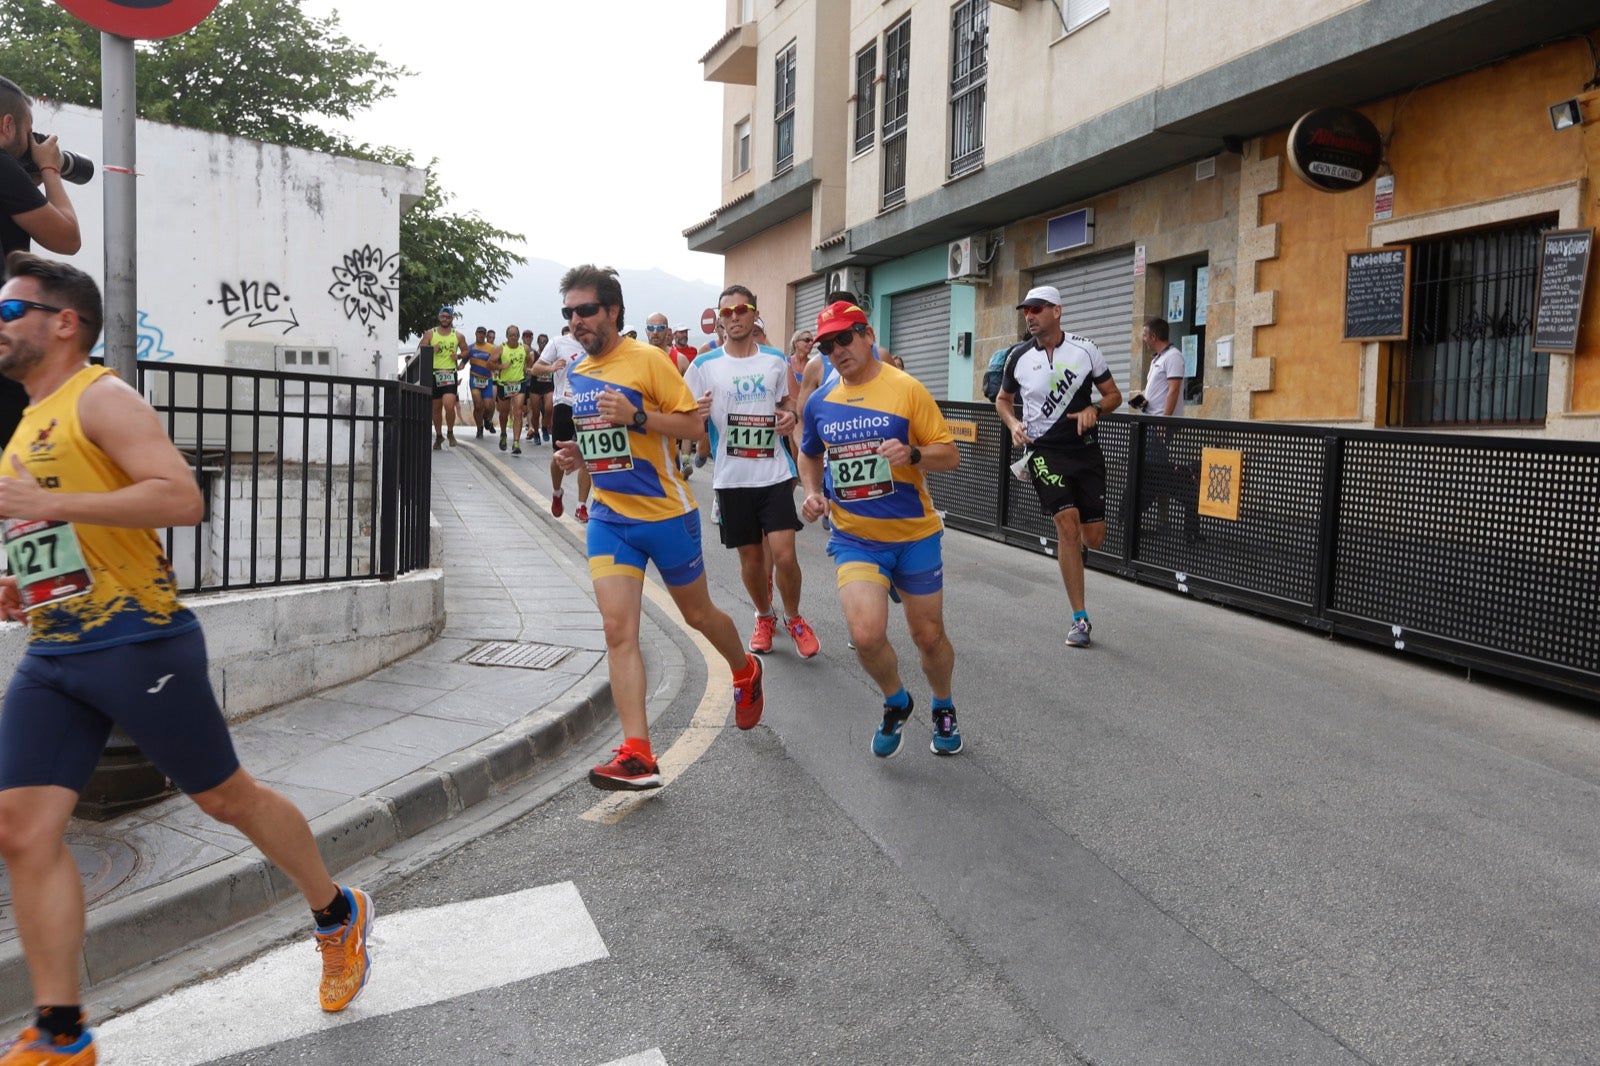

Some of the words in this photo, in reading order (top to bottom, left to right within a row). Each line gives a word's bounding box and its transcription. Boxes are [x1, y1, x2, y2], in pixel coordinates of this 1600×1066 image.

[1350, 252, 1402, 268] RACIONES
[730, 428, 775, 445] 1117
[823, 415, 890, 438] agustinos
[832, 430, 879, 441] GRANADA
[580, 431, 626, 455] 1190
[838, 458, 878, 483] 827
